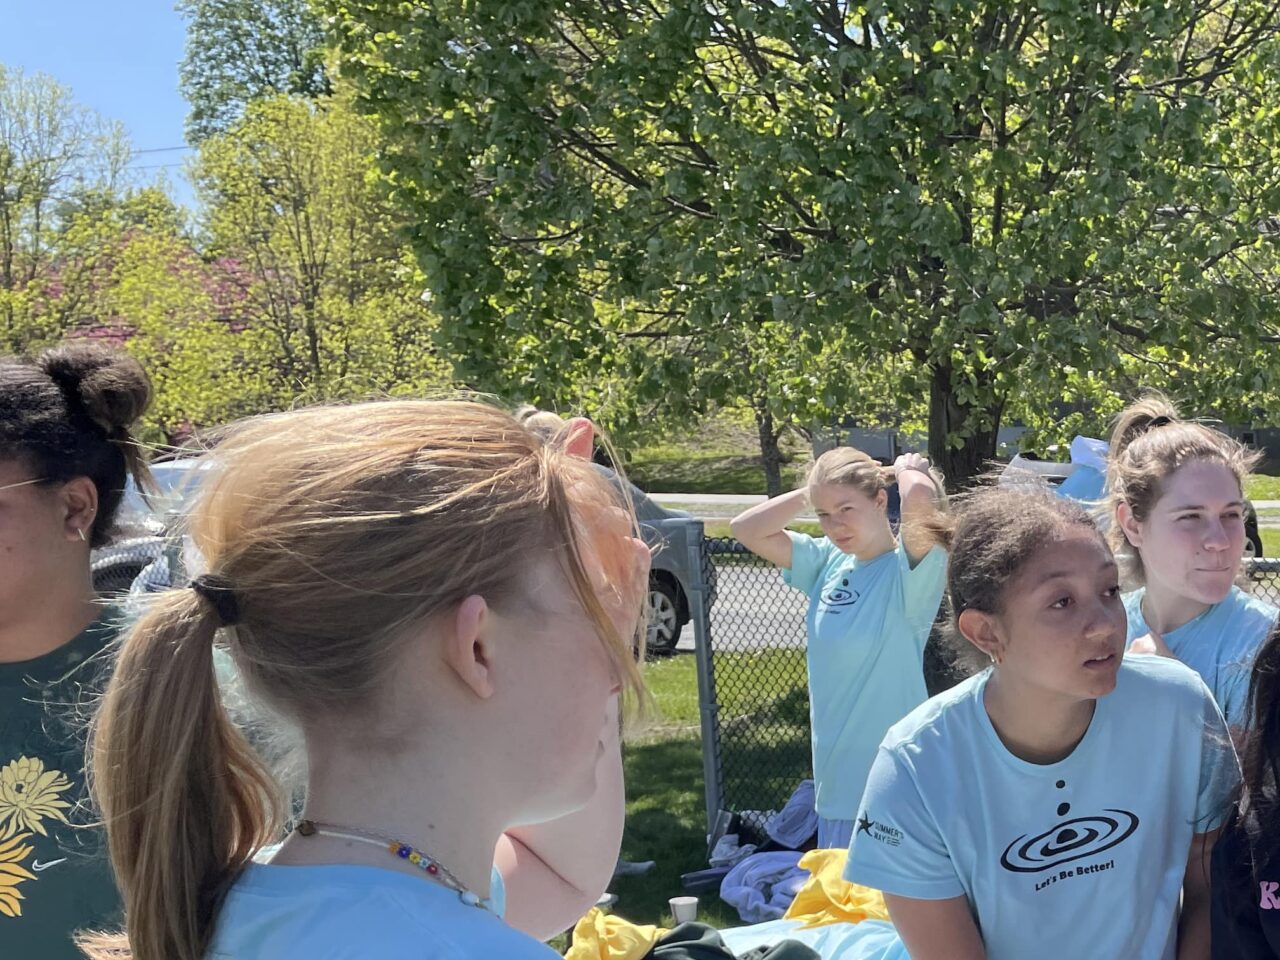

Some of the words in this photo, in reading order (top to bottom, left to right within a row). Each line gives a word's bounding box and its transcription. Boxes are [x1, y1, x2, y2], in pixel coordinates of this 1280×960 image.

[1035, 875, 1057, 891] Let's
[1059, 870, 1074, 880] Be
[1076, 860, 1115, 876] Better!
